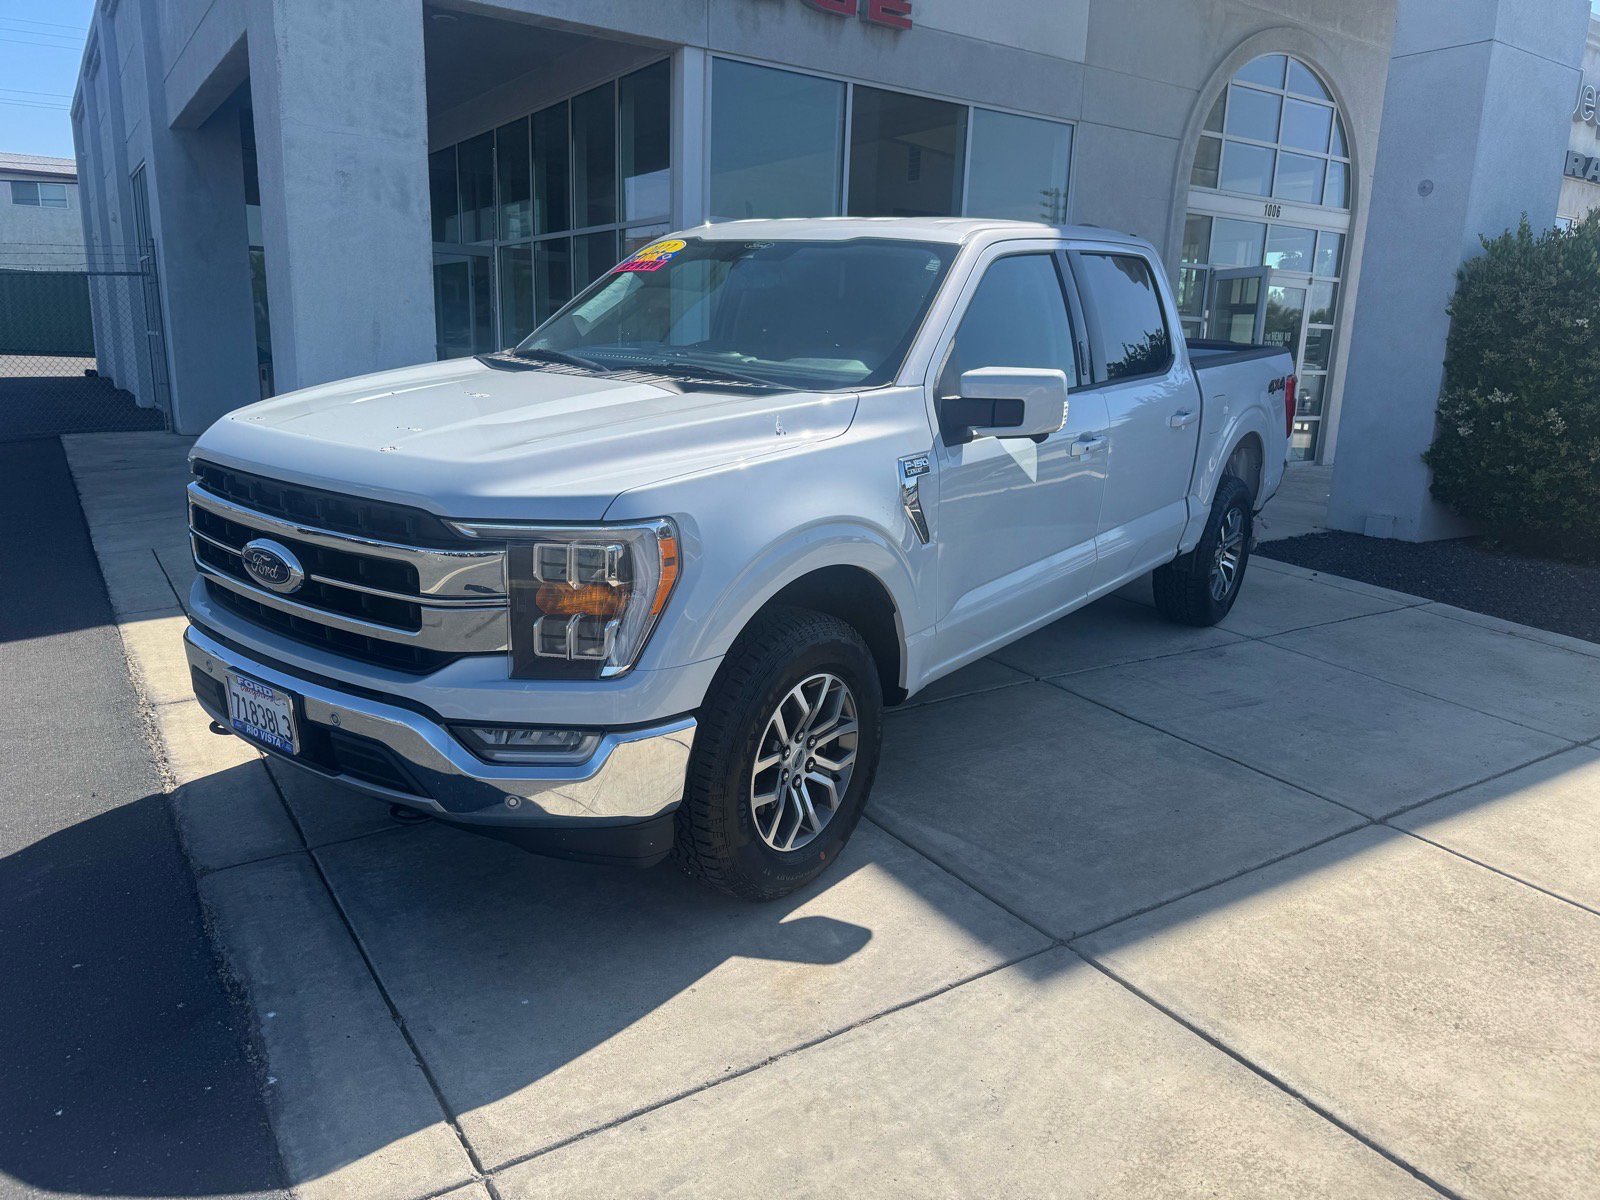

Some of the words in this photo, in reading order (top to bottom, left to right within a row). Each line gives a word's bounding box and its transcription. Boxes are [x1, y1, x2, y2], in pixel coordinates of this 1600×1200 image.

[1573, 68, 1600, 121] Je
[1264, 203, 1281, 218] 1006
[904, 457, 929, 470] F-150
[250, 552, 279, 579] Ford
[237, 677, 273, 697] FORD
[233, 691, 293, 742] 71838L3
[246, 724, 259, 737] RIO
[260, 730, 281, 748] VISTA
